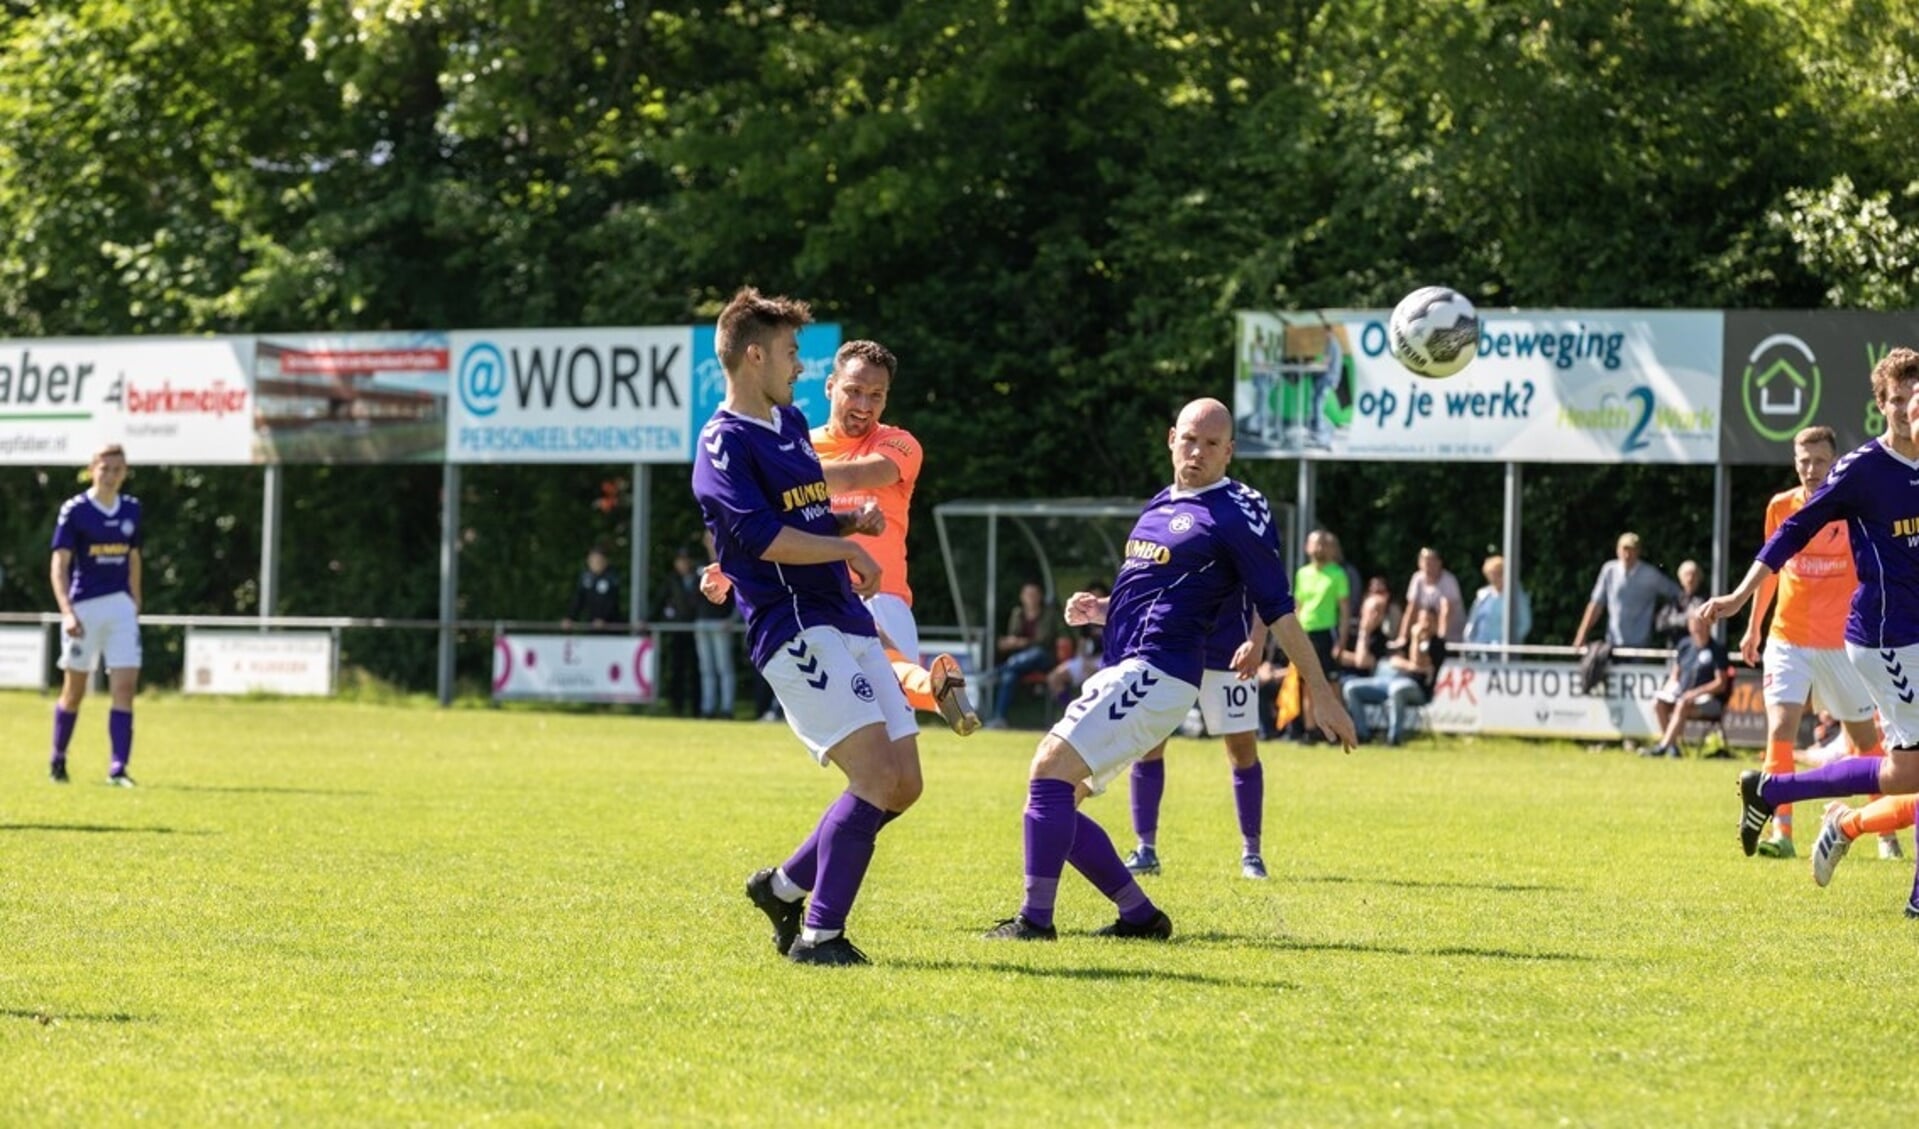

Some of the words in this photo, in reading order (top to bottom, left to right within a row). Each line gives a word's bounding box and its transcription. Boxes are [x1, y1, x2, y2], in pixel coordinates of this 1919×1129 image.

[1478, 316, 1624, 370] beweging
[127, 379, 248, 420] barkmeijer
[1359, 388, 1397, 428] op
[1404, 384, 1433, 428] je
[1444, 381, 1535, 418] werk?
[1622, 386, 1656, 454] 2
[459, 427, 682, 450] PERSONEELSDIENSTEN
[1223, 685, 1248, 708] 10
[1486, 668, 1560, 698] AUTO
[1568, 671, 1668, 699] BERD
